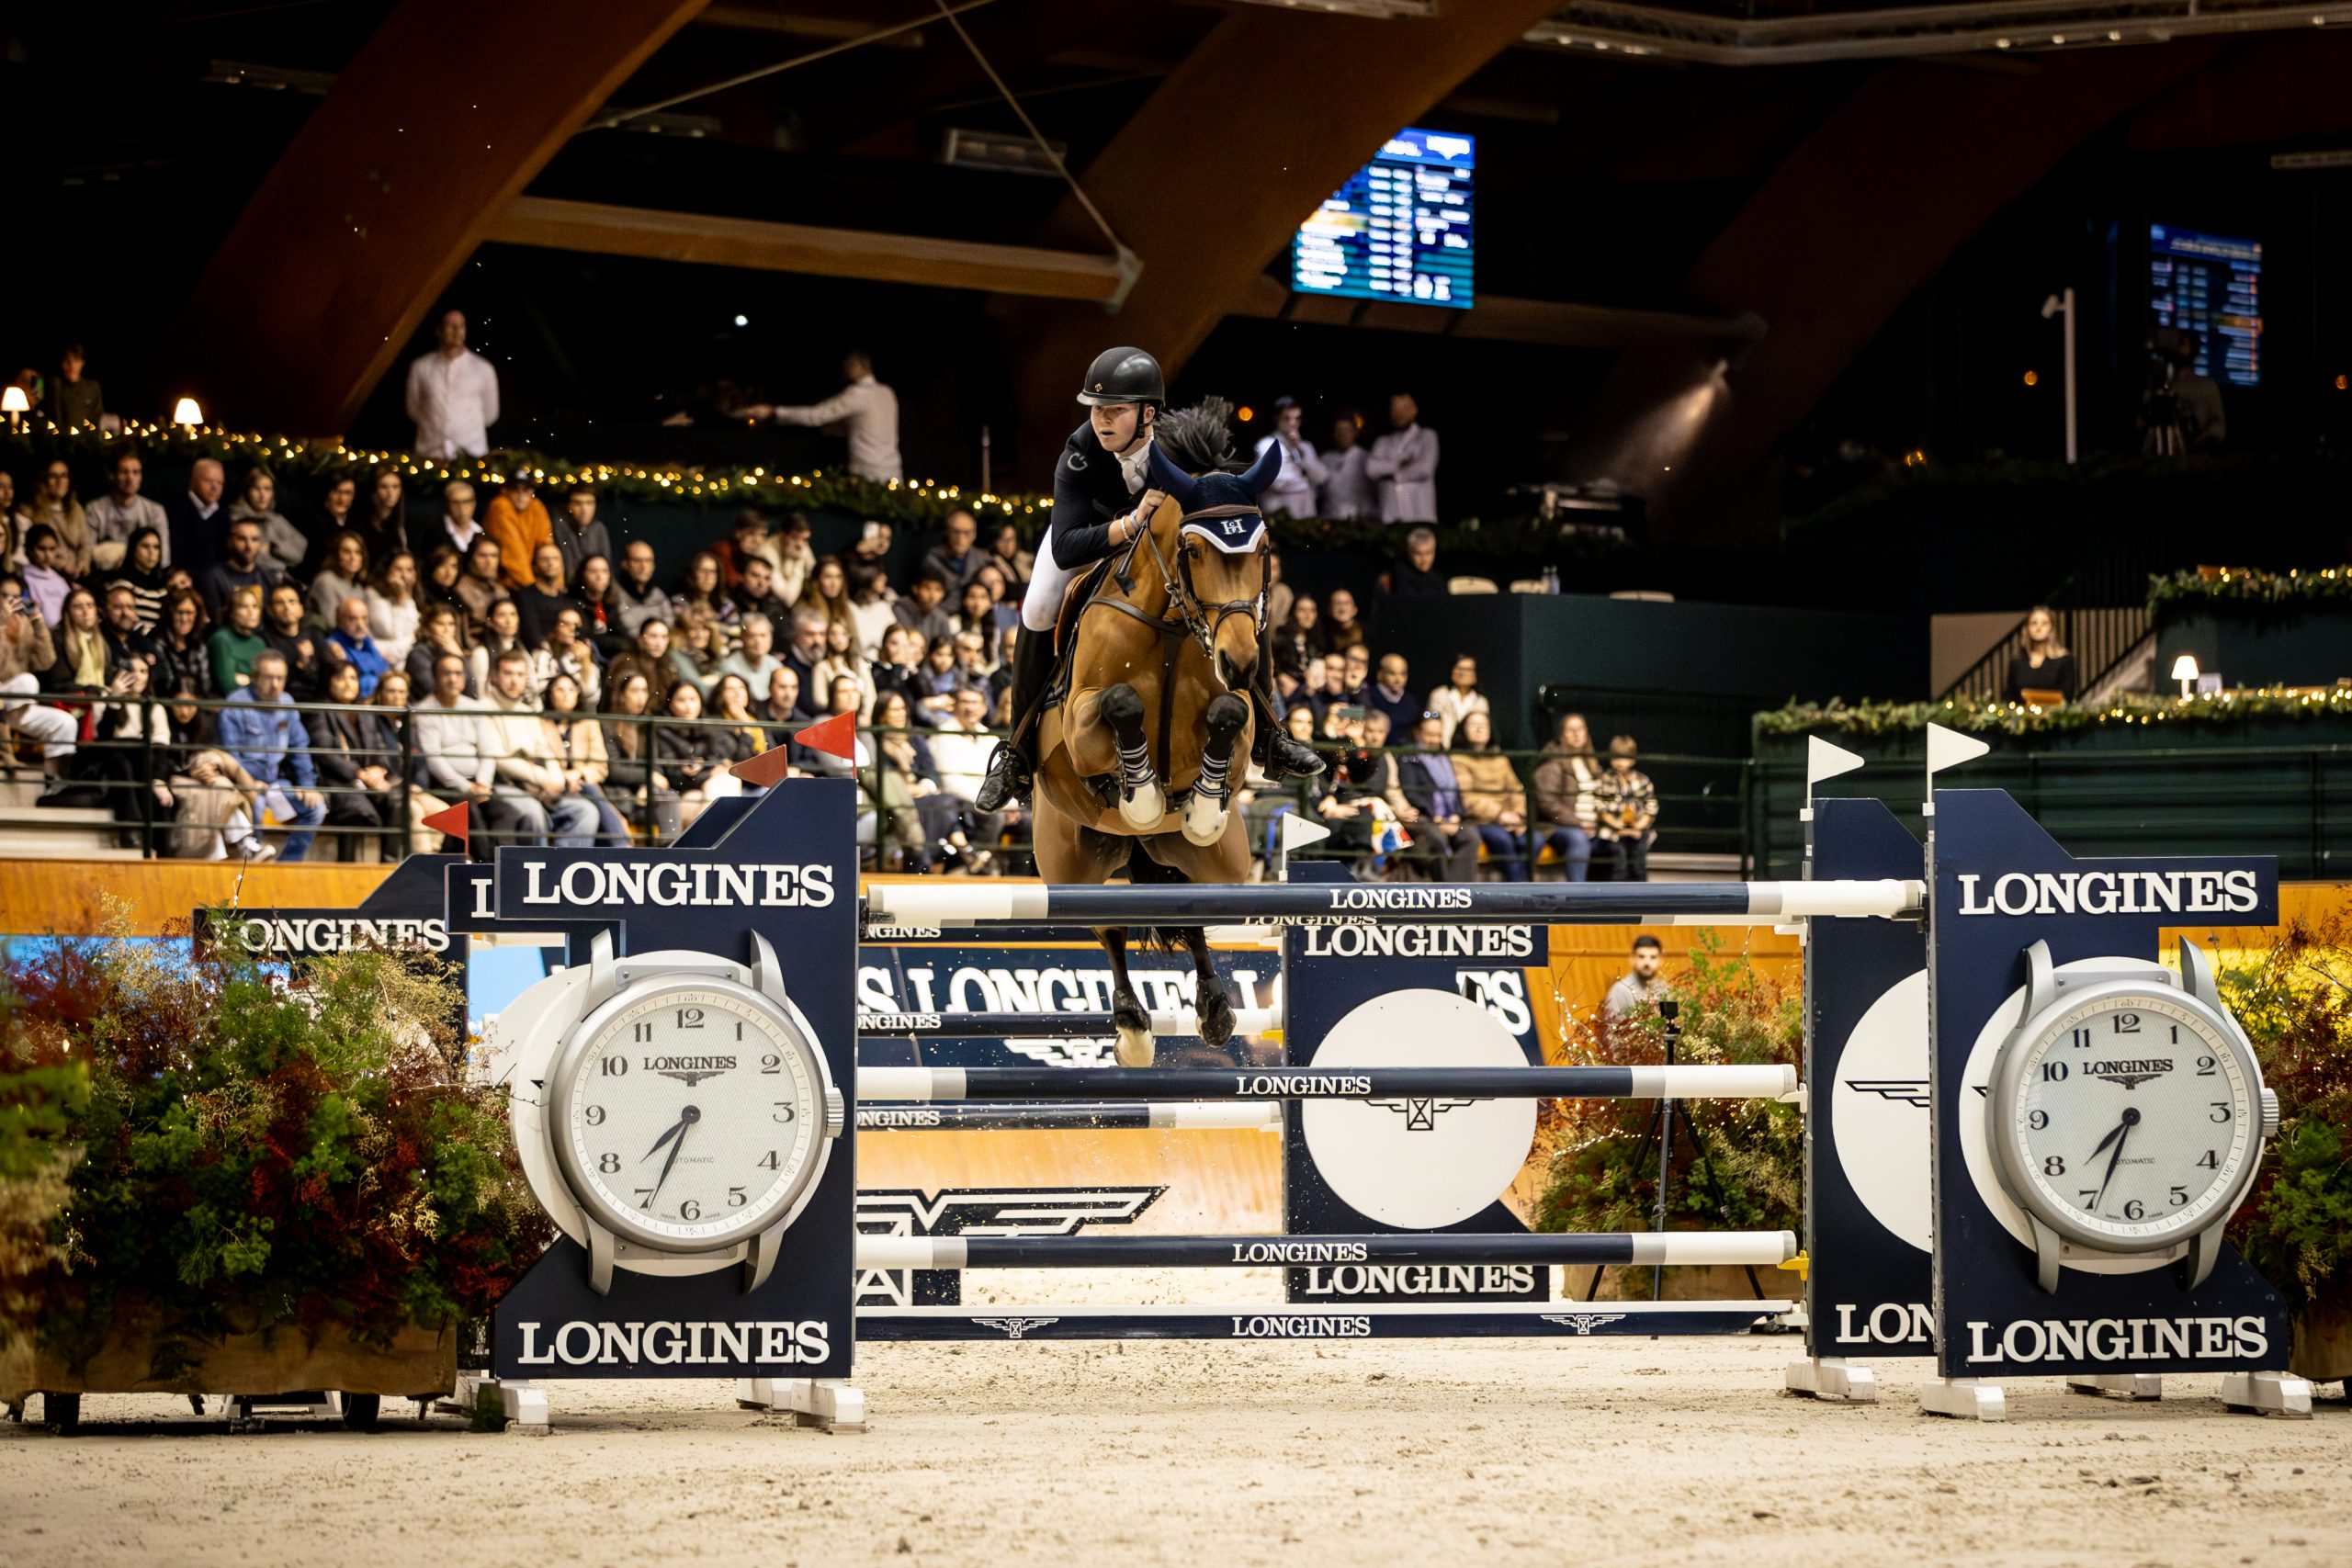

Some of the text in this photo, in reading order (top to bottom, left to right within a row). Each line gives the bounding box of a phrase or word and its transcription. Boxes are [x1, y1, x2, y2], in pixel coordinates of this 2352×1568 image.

[523, 861, 835, 908] LONGINES
[1957, 870, 2259, 916] LONGINES
[1329, 887, 1473, 909] LONGINES
[216, 918, 450, 953] ONGINES
[1304, 924, 1533, 957] LONGINES
[675, 1009, 705, 1029] 12
[857, 1014, 942, 1029] NGINES
[2111, 1013, 2142, 1034] 12
[633, 1022, 652, 1043] 11
[735, 1021, 743, 1042] 1
[2072, 1028, 2091, 1048] 11
[2169, 1024, 2178, 1045] 1
[601, 1055, 628, 1077] 10
[643, 1055, 738, 1071] LONGINES
[761, 1054, 781, 1074] 2
[2041, 1061, 2069, 1082] 10
[2082, 1058, 2175, 1076] LONGINES
[2196, 1055, 2216, 1077] 2
[1236, 1076, 1372, 1095] LONGINES
[585, 1105, 606, 1126] 9
[773, 1101, 795, 1123] 3
[856, 1110, 941, 1126] NGINES
[2029, 1109, 2050, 1131] 9
[2210, 1101, 2231, 1123] 3
[599, 1152, 621, 1174] 8
[756, 1150, 781, 1171] 4
[2043, 1156, 2066, 1177] 8
[2195, 1149, 2220, 1170] 4
[634, 1188, 655, 1210] 7
[727, 1185, 748, 1207] 5
[2078, 1190, 2099, 1211] 7
[2169, 1185, 2188, 1206] 5
[680, 1199, 701, 1221] 6
[2123, 1199, 2144, 1221] 6
[1232, 1243, 1368, 1262] LONGINES
[1306, 1266, 1535, 1294] LONGINES
[1232, 1316, 1372, 1337] LONGINES
[517, 1320, 831, 1366] LONGINES
[1965, 1315, 2268, 1363] LONGINES
